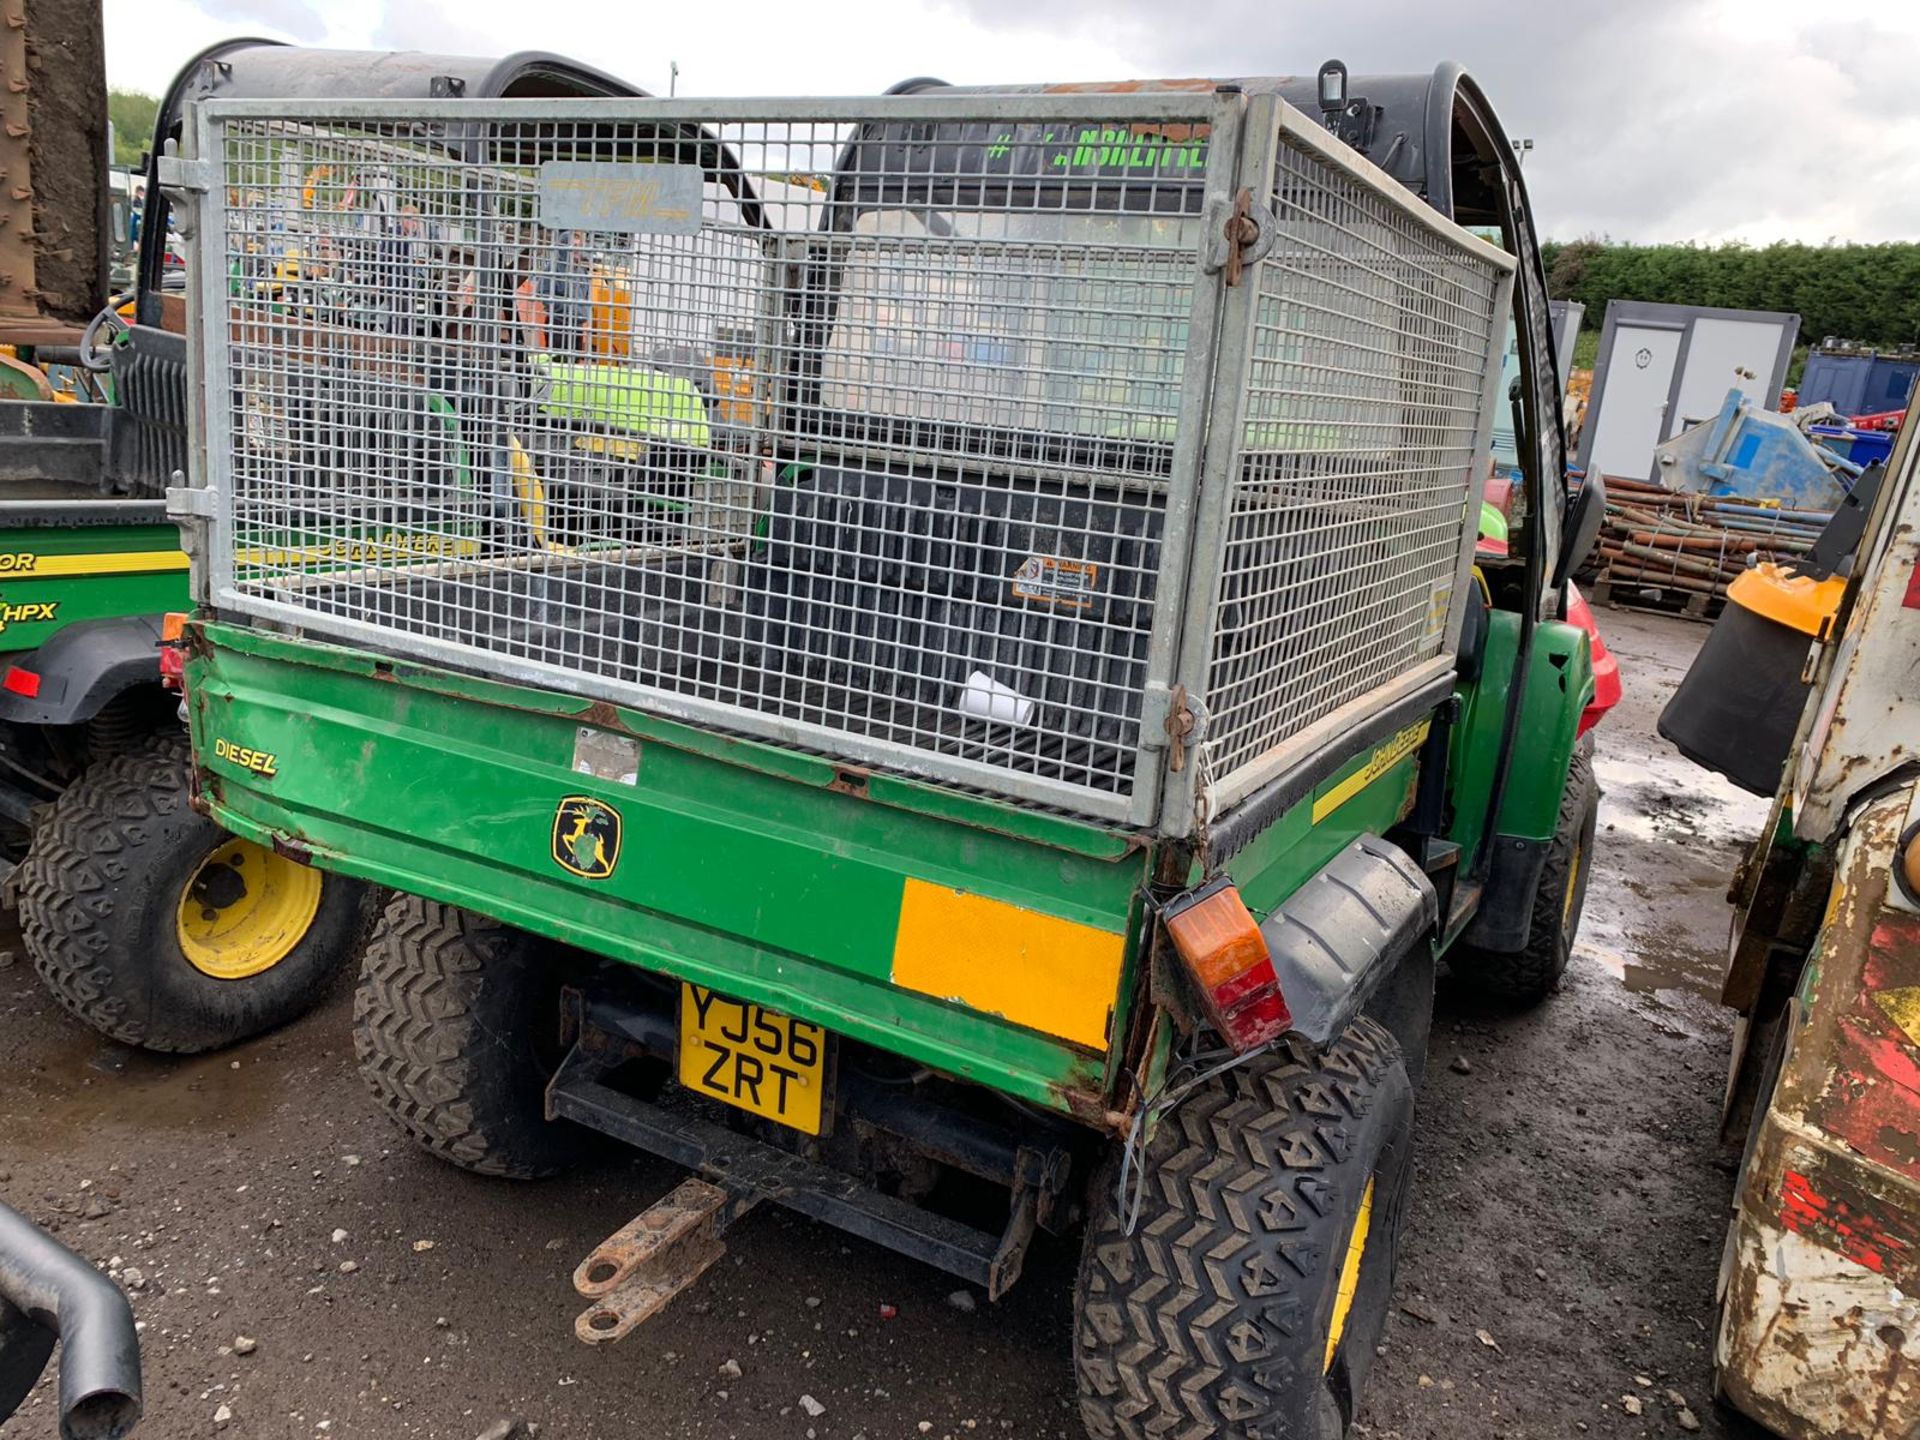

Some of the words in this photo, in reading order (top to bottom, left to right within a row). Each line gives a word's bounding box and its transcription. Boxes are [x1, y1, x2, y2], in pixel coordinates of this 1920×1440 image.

[3, 602, 57, 622] HPX
[215, 738, 277, 775] DIESEL
[689, 985, 818, 1067] YJ56
[702, 1040, 799, 1115] ZRT
